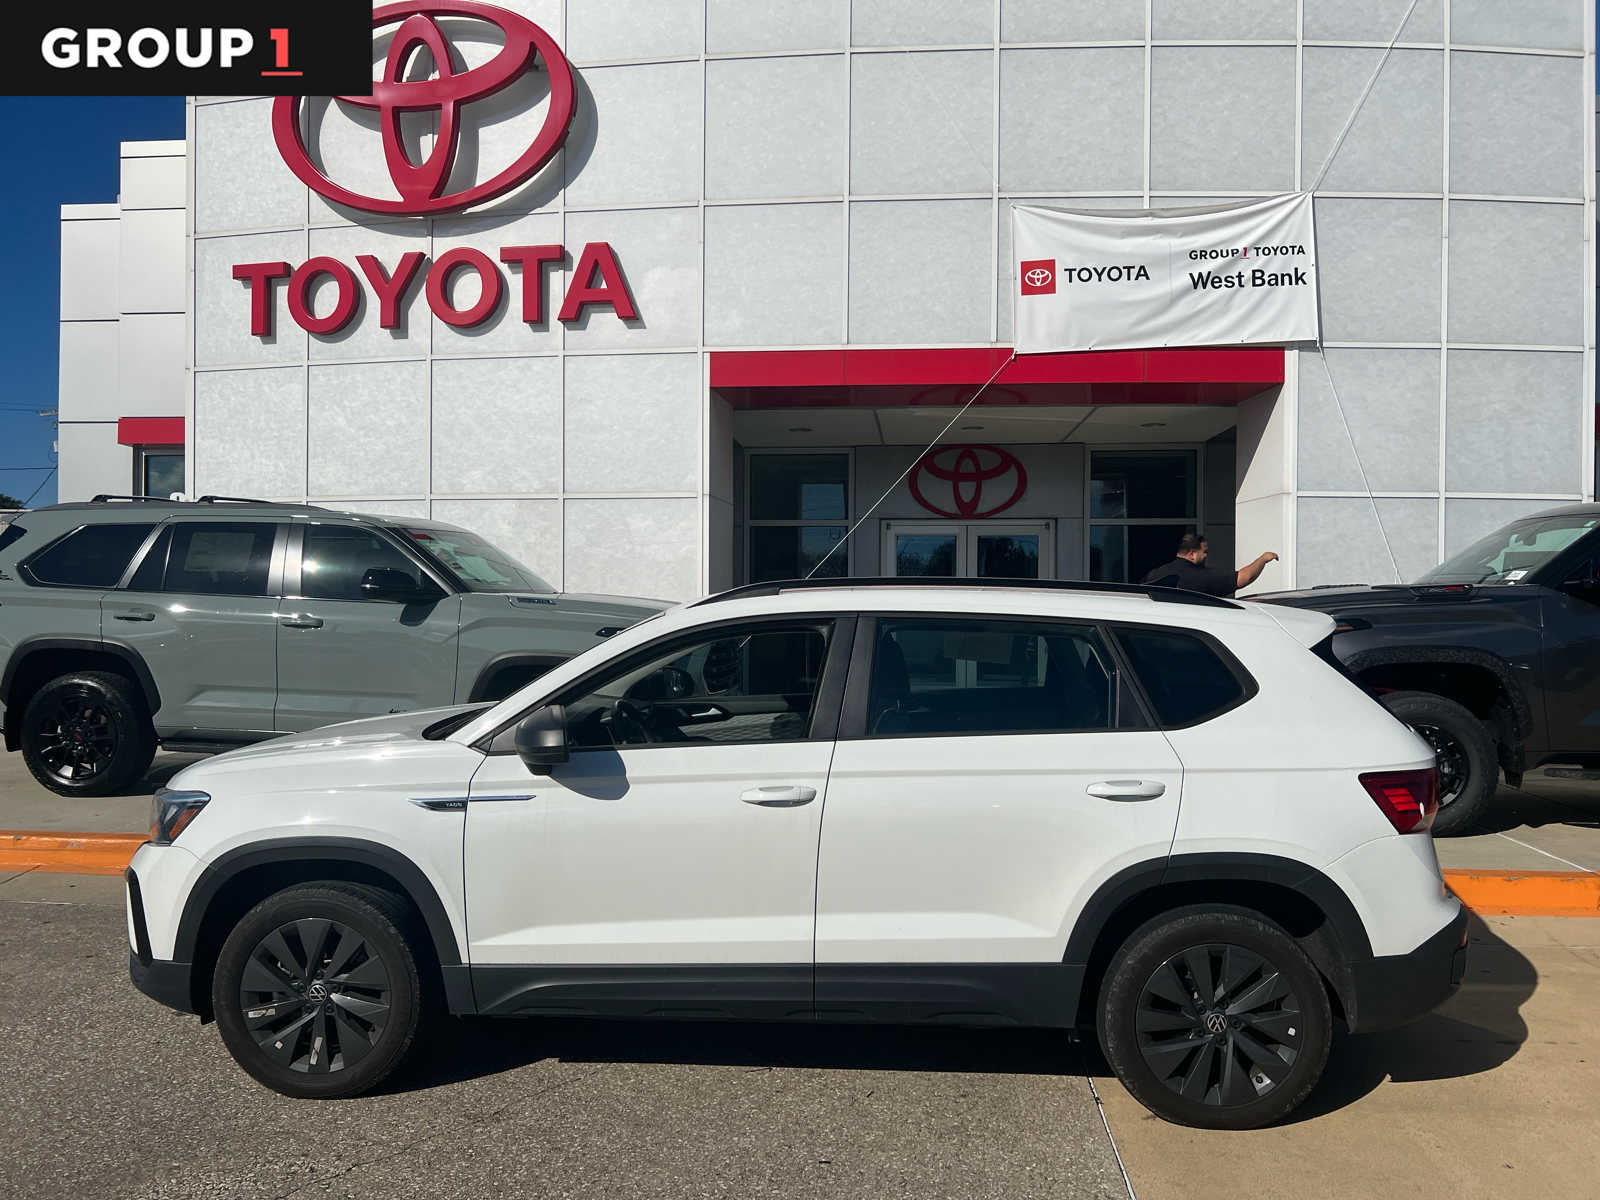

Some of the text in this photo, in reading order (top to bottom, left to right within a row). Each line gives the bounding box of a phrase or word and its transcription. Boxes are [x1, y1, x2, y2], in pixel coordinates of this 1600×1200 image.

[1189, 245, 1306, 261] GROUP 1 TOYOTA
[1064, 265, 1150, 283] TOYOTA
[1189, 267, 1307, 290] West Bank
[232, 242, 638, 335] TOYOTA
